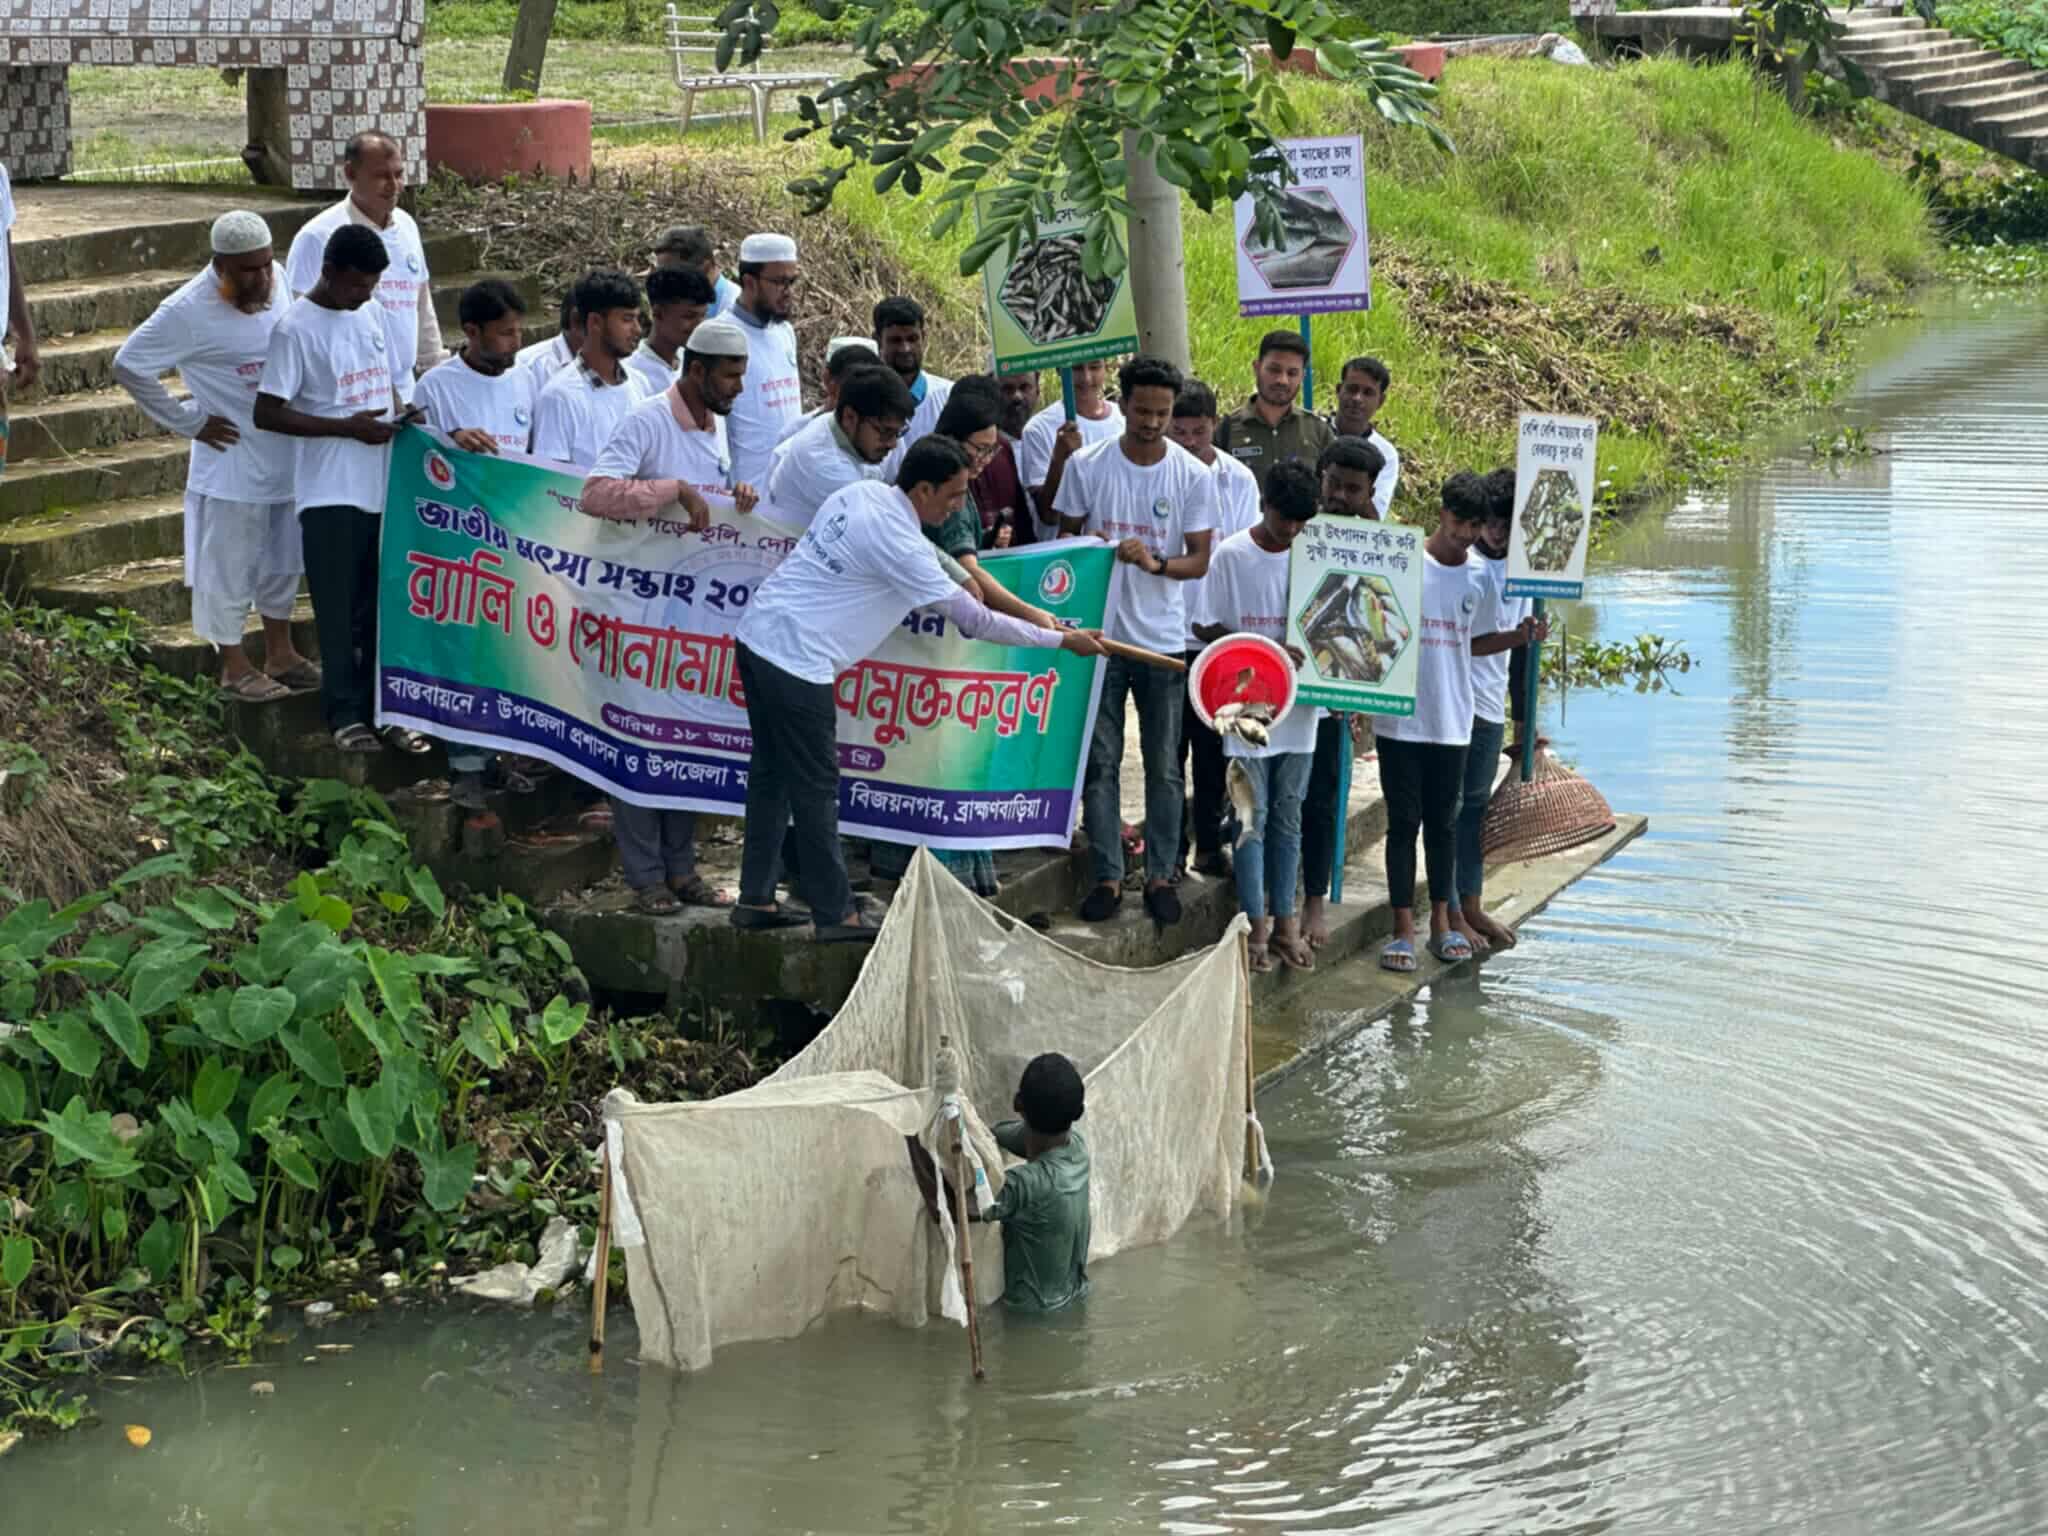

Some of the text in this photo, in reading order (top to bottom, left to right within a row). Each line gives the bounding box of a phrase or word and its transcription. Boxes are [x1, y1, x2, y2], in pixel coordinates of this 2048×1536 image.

[1331, 165, 1352, 178] মাস
[1325, 521, 1369, 544] উৎপাদন
[1395, 532, 1417, 552] করি
[415, 496, 511, 552] জাতীয়
[512, 536, 593, 588] মৎস্য
[597, 559, 698, 607] সপ্তাহ
[704, 577, 760, 611] ২০
[1362, 551, 1385, 568] দেশ
[1387, 551, 1410, 575] গড়ি
[526, 591, 558, 650] ও
[831, 657, 1058, 746] বমুক্তকরণ
[672, 725, 701, 741] ১৮
[386, 675, 475, 715] বাস্তবায়নে
[495, 693, 566, 741] উপজেলা
[568, 728, 620, 766] প্রশাসন
[623, 752, 640, 774] ও
[644, 752, 730, 787] উপজেলা
[848, 781, 950, 825] বিজয়নগর,
